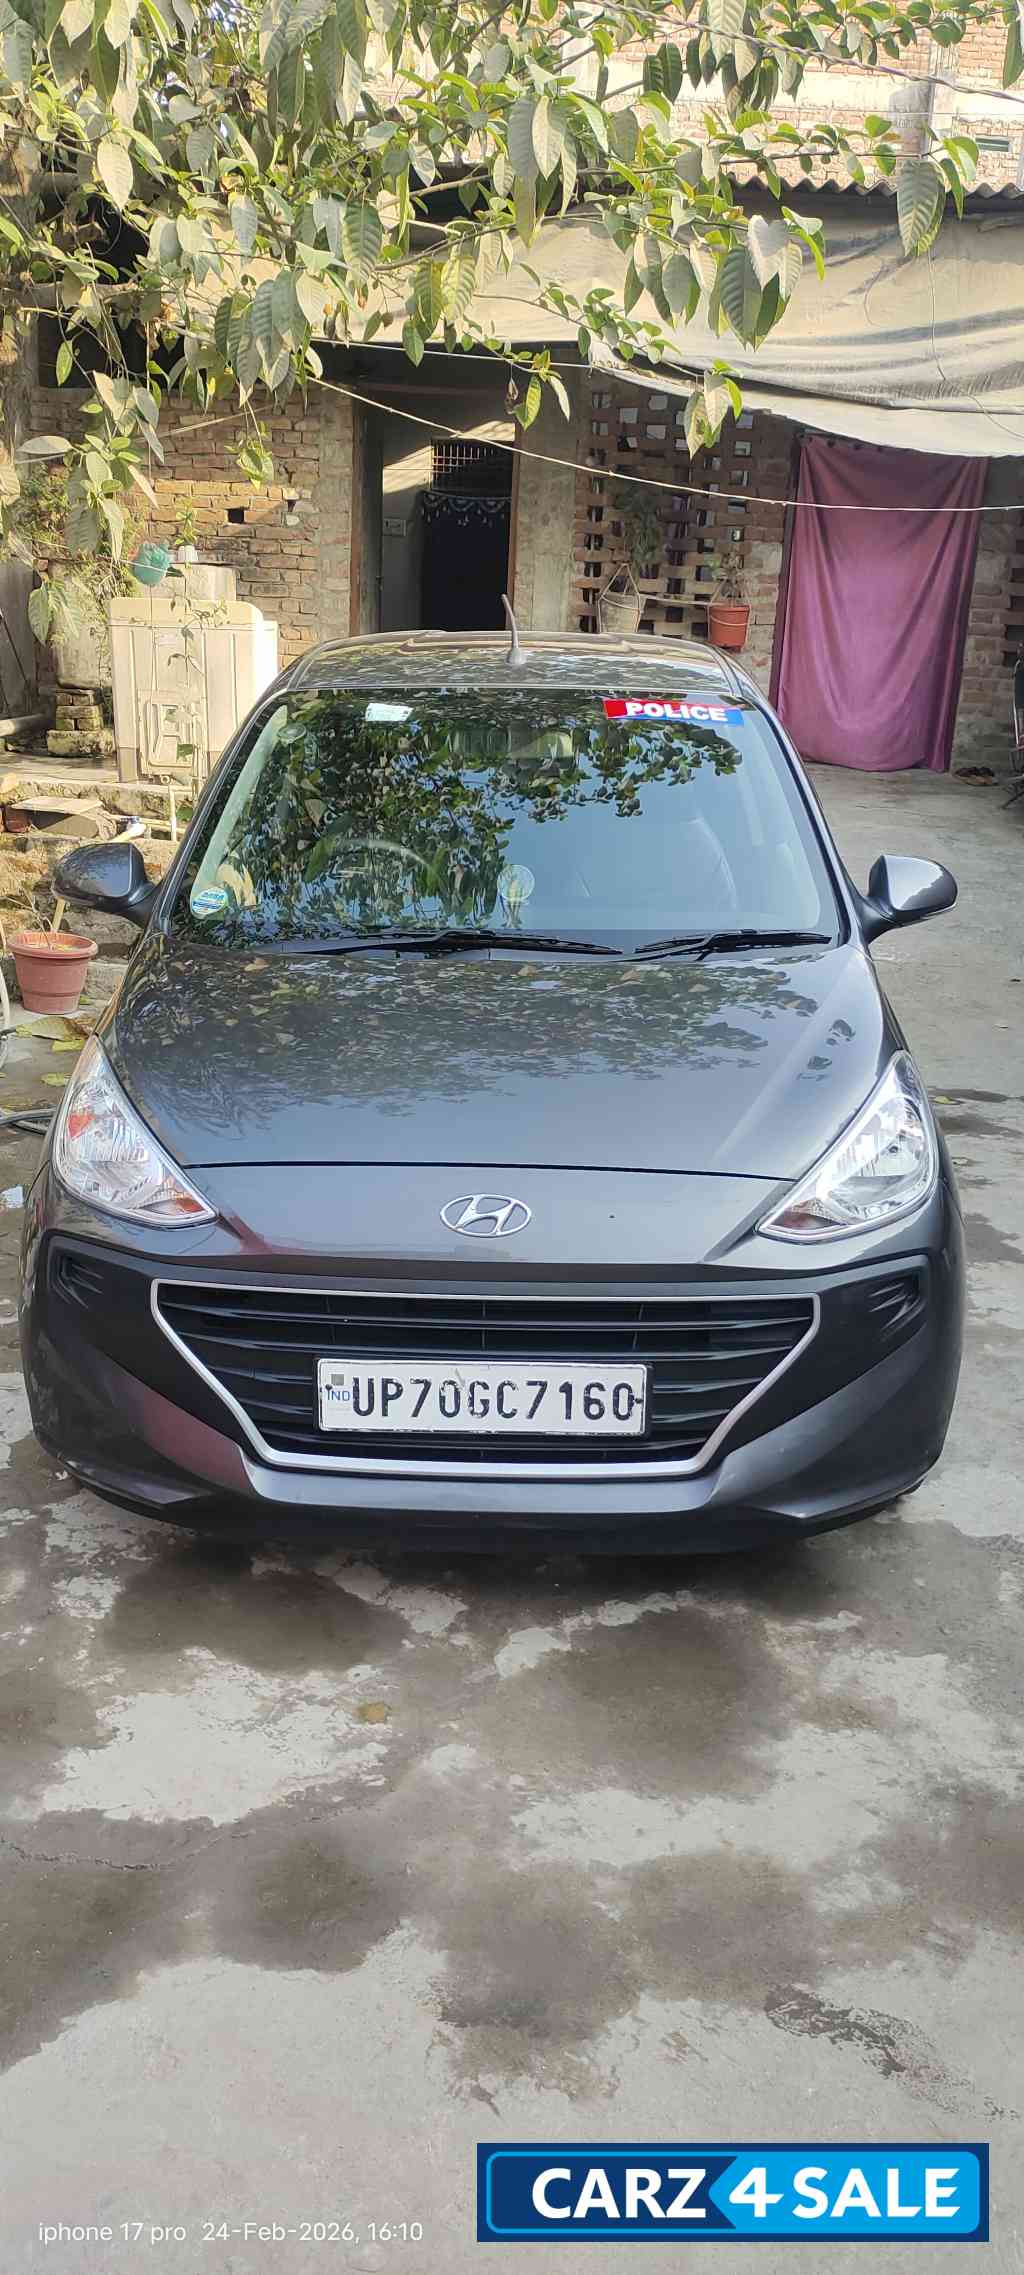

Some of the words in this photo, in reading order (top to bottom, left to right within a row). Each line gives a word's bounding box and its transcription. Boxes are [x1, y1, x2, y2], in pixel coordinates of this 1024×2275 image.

[625, 702, 728, 721] POLICE
[326, 1389, 350, 1401] IND
[352, 1376, 635, 1421] UP70GC7160
